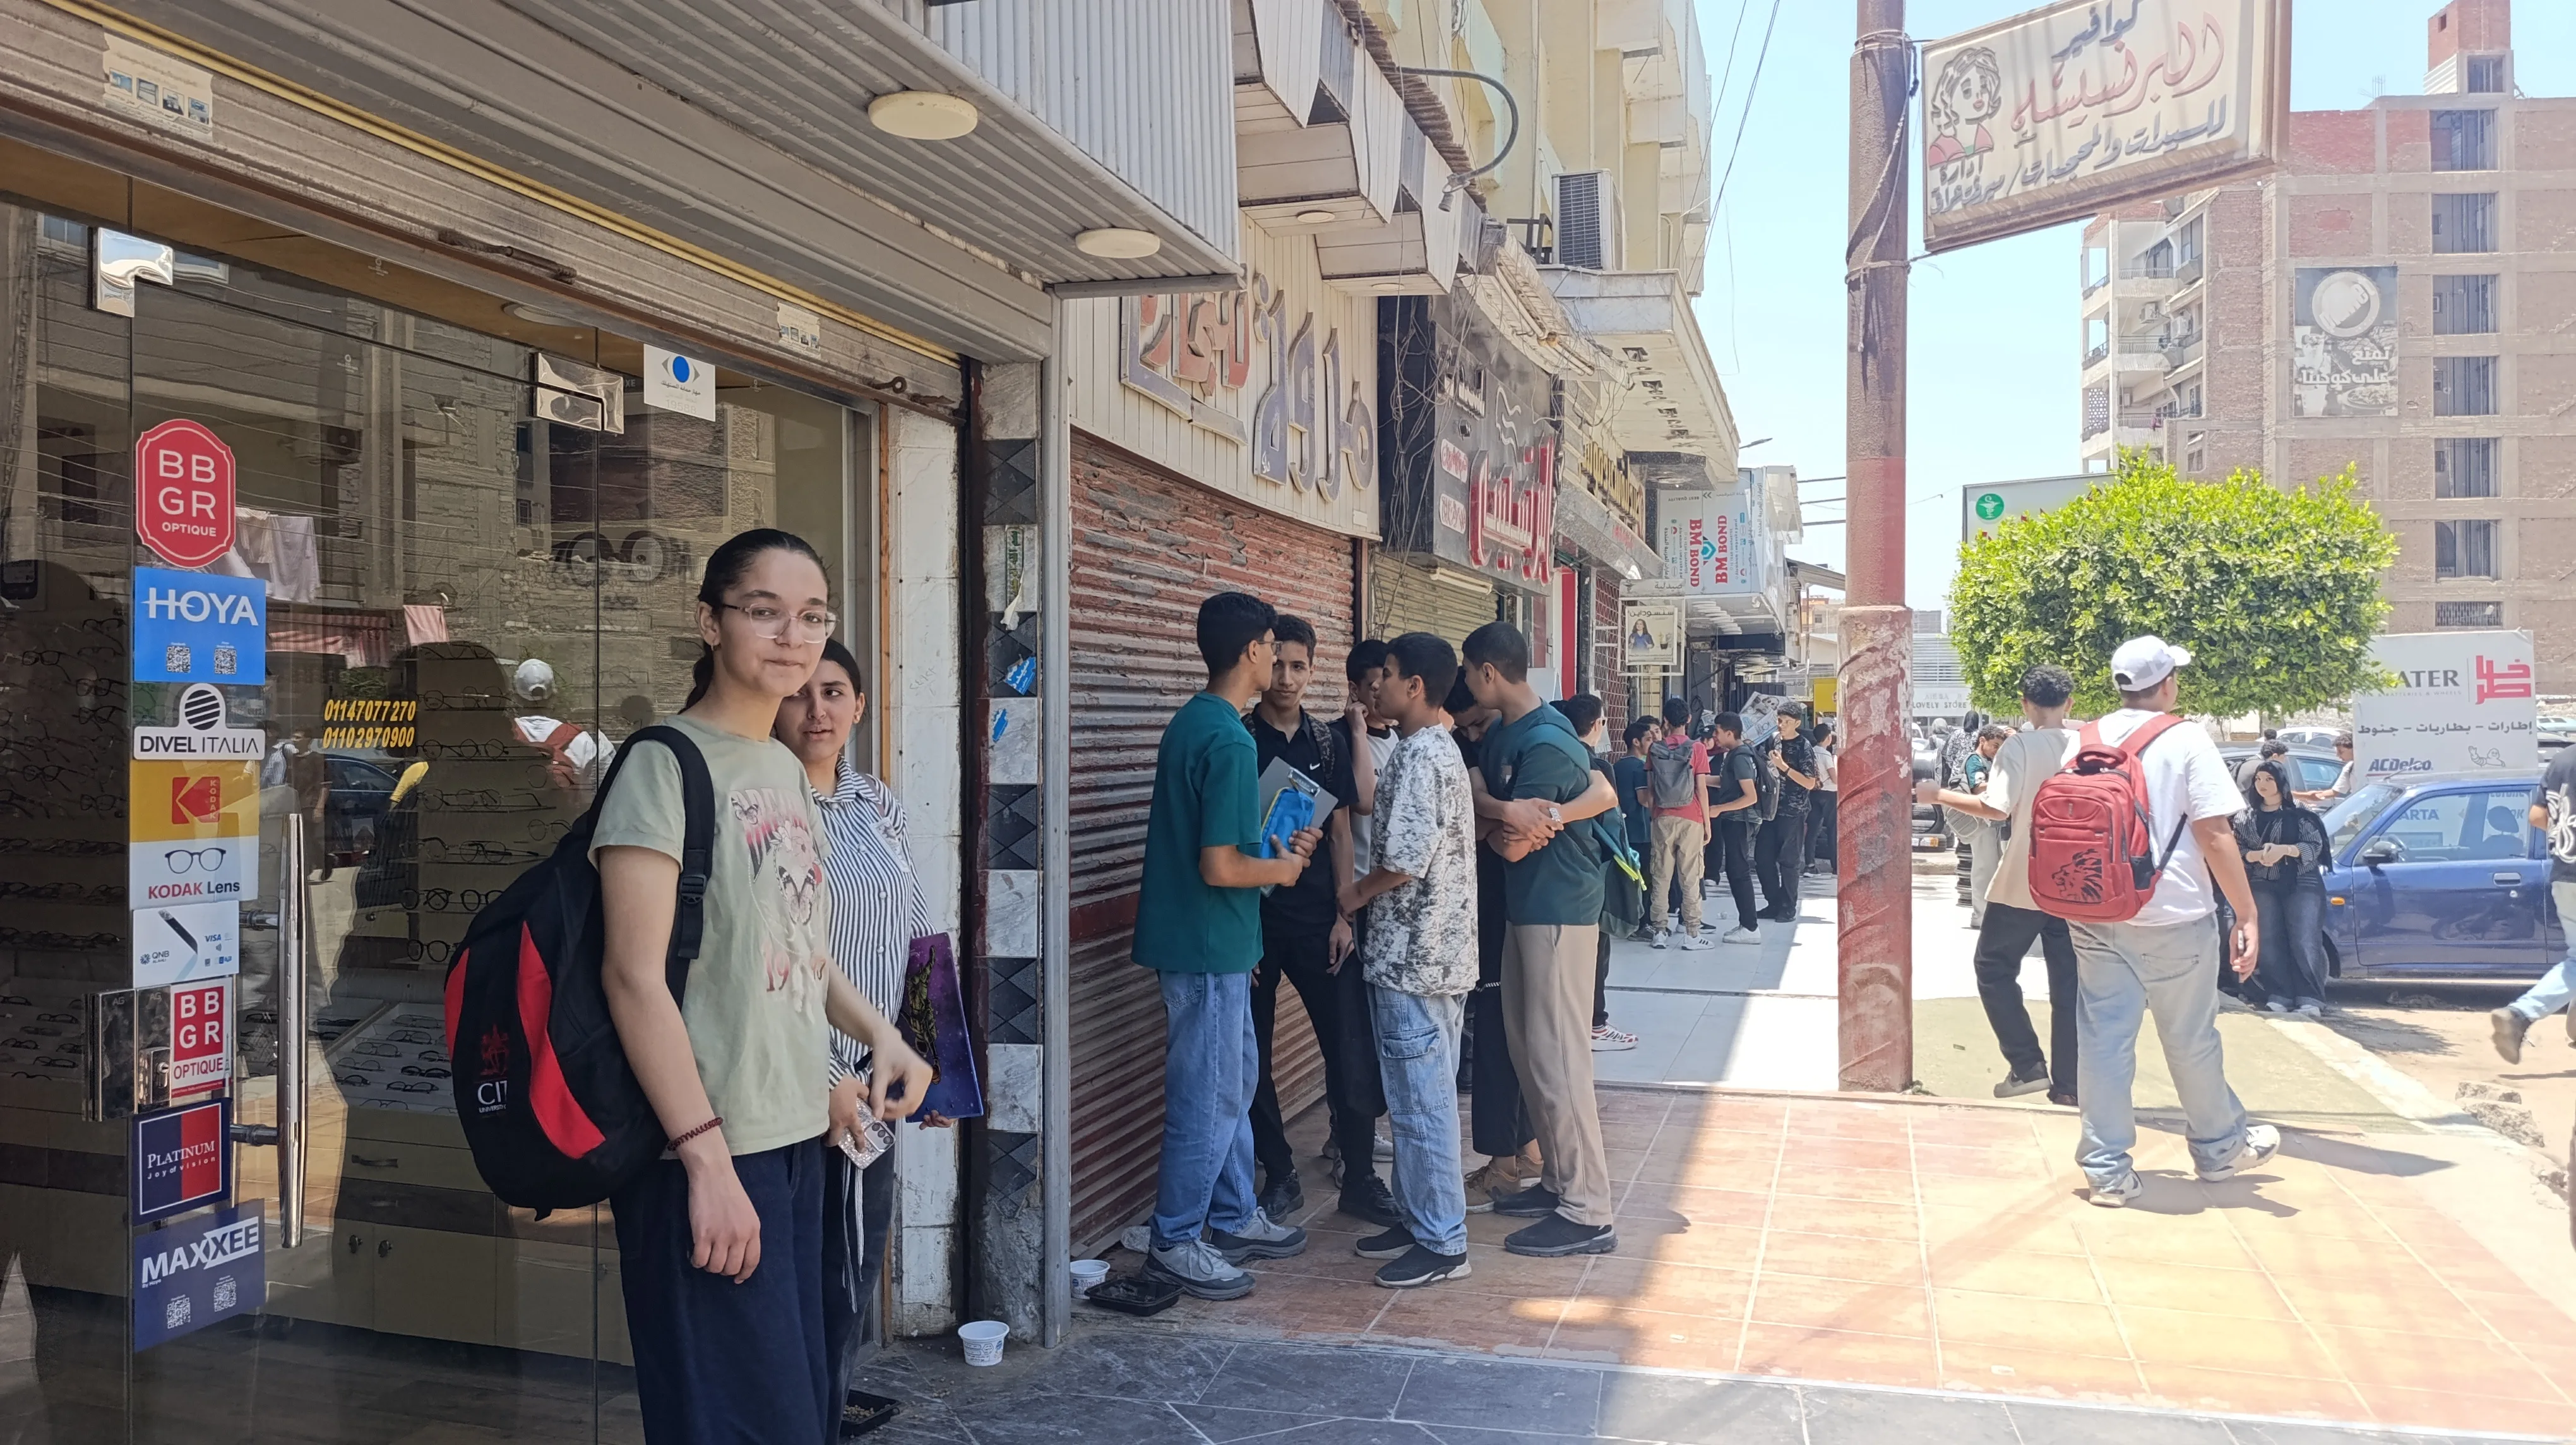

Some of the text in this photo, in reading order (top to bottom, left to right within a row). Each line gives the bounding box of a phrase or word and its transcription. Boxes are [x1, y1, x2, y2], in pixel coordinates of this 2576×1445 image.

[2125, 94, 2226, 155] للسيدات
[2021, 123, 2122, 186] والمحجبات
[162, 522, 217, 537] OPTIQUE
[1690, 519, 1702, 587] BM BOND
[1715, 515, 1728, 584] BM BOND
[1654, 582, 1683, 591] صيدلية
[141, 587, 259, 626] HOYA
[2399, 670, 2460, 688] ATER
[325, 700, 416, 721] 01147077270
[2358, 724, 2399, 736] جنوط
[2416, 722, 2471, 735] بطاريات
[2488, 721, 2532, 734] إطارات
[140, 736, 259, 753] DIVEL ITALIA
[323, 727, 414, 748] 01102970900
[2368, 758, 2432, 772] ACDelco
[209, 780, 217, 819] KODAK
[2399, 809, 2440, 820] ARTA
[148, 881, 240, 899] KODAK Lens
[205, 934, 222, 942] VISA
[152, 950, 170, 959] QNB
[174, 1057, 224, 1079] OPTIQUE
[477, 1081, 507, 1105] CIT
[148, 1169, 167, 1179] Joy
[180, 1156, 215, 1170] vision
[142, 1223, 258, 1283] MAXXEE
